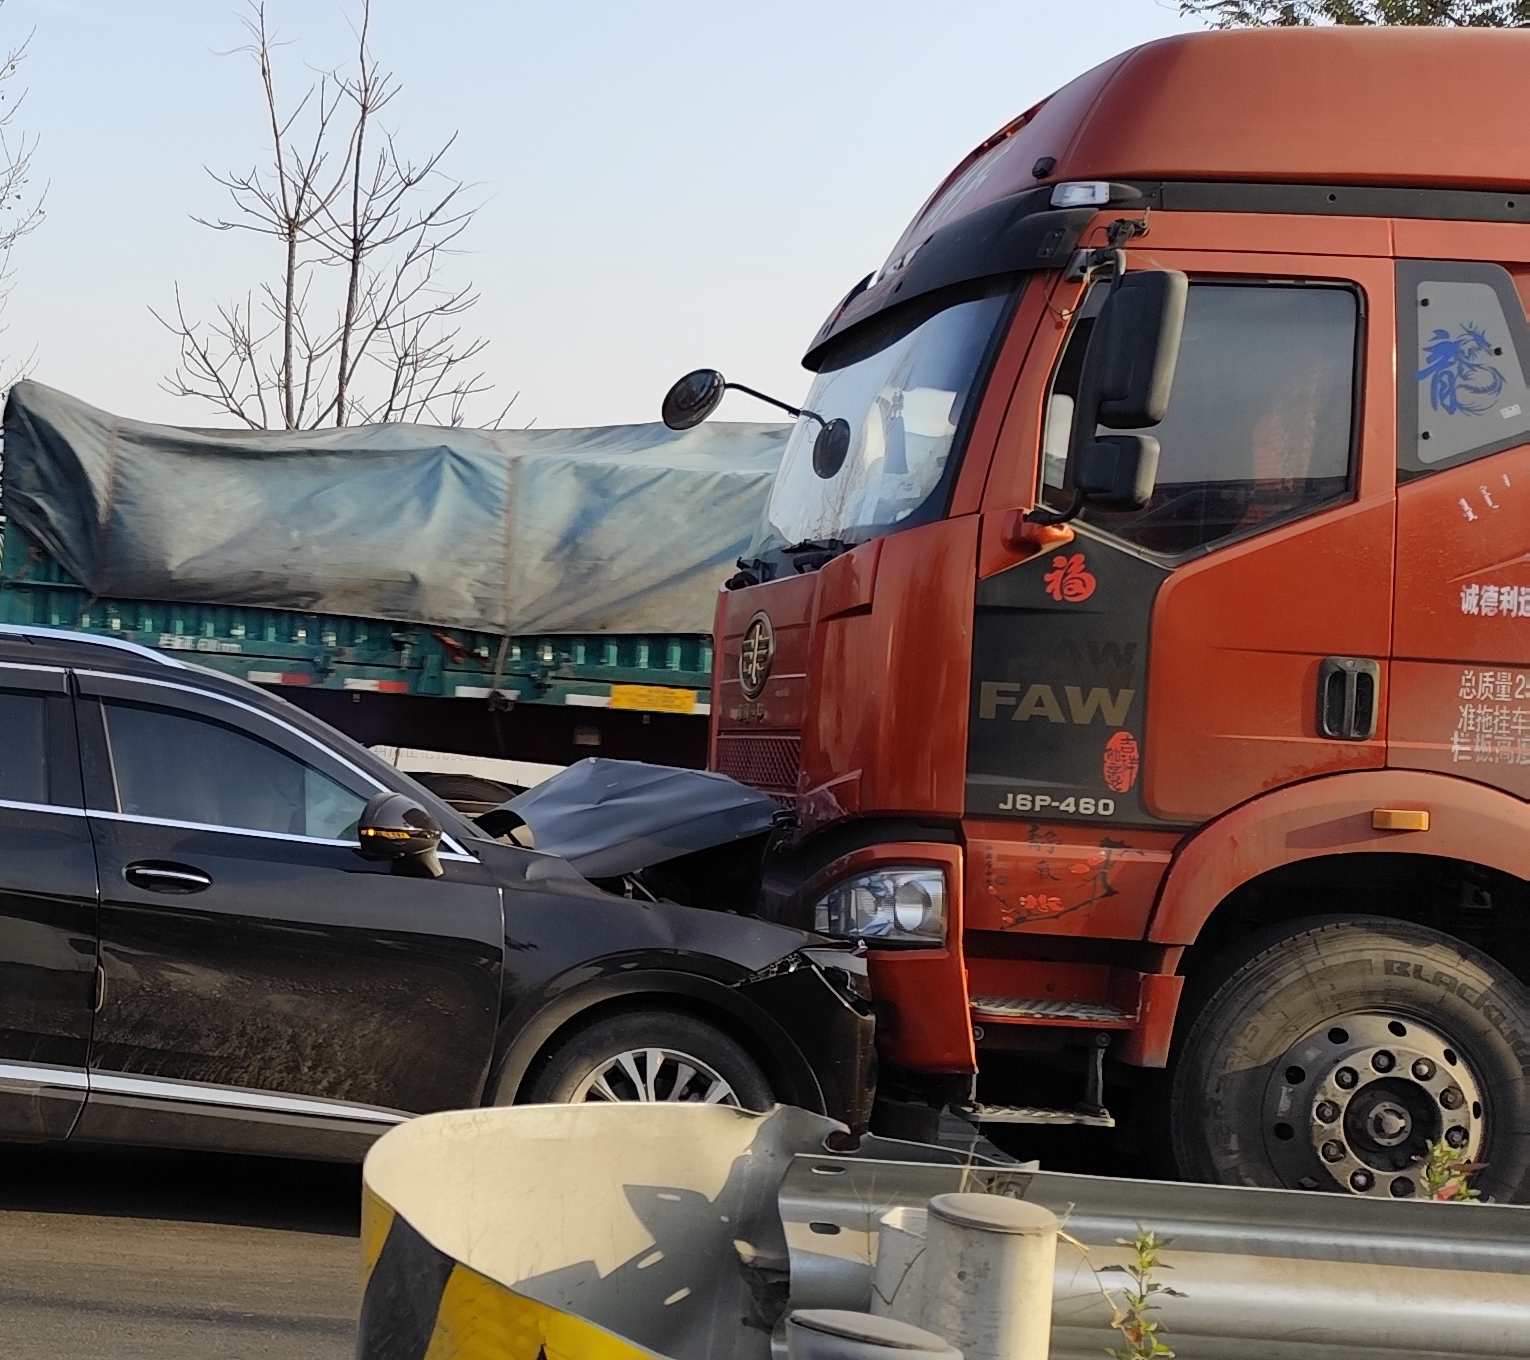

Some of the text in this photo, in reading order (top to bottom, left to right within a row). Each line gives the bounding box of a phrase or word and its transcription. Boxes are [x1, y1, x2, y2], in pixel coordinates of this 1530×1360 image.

[1043, 553, 1097, 603] 福
[978, 681, 1137, 727] FAW
[998, 792, 1116, 817] J6P-460
